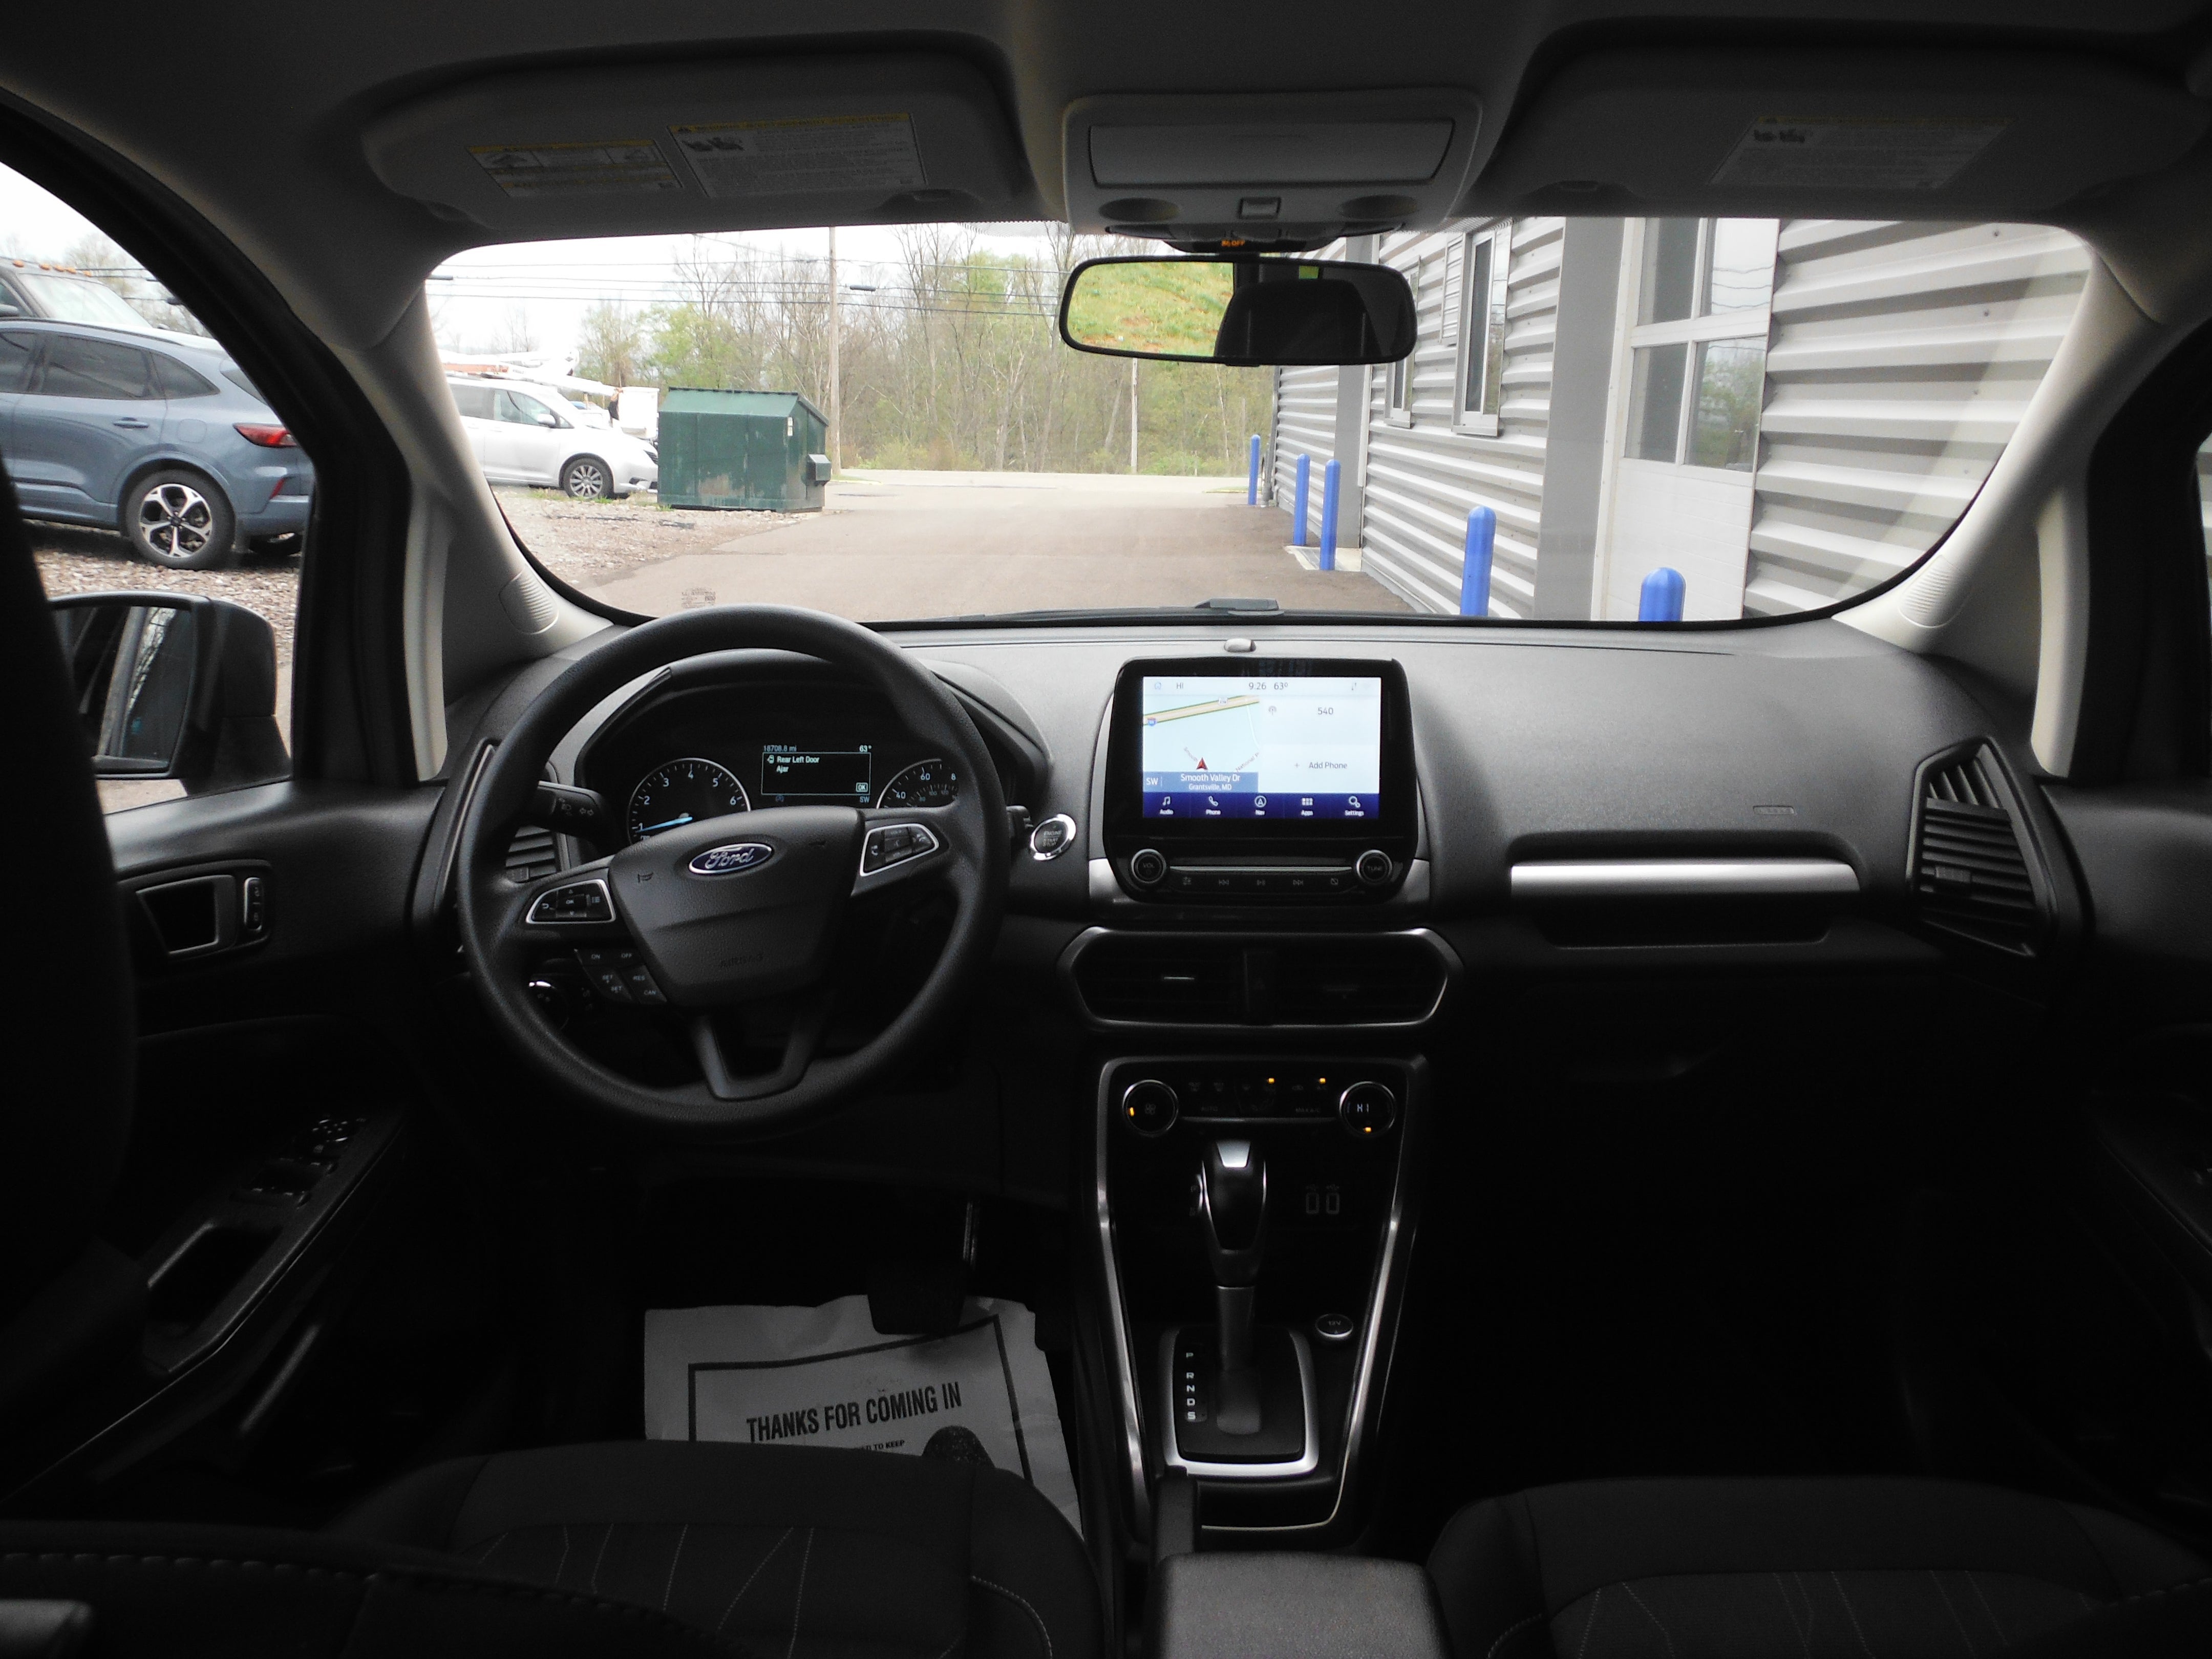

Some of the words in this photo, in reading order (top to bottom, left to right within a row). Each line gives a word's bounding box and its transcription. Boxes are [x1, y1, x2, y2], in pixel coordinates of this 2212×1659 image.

[776, 755, 791, 763] Rear
[792, 755, 804, 763] Left
[805, 755, 820, 763] Door
[776, 765, 789, 774] Ajar
[688, 770, 694, 780] 4
[1180, 773, 1208, 782] Smooth
[1209, 773, 1231, 782] Valley
[1232, 773, 1240, 781] Dr
[663, 778, 670, 787] 3
[712, 777, 719, 787] 5
[895, 791, 906, 799] 40
[644, 795, 650, 805] 2
[729, 795, 736, 806] 6
[639, 822, 644, 831] 1
[705, 846, 755, 869] Ford
[1186, 1397, 1196, 1406] D
[746, 1408, 819, 1442] THANKS
[824, 1401, 861, 1431] FOR
[866, 1386, 939, 1423] COMING
[942, 1381, 962, 1409] IN
[1187, 1411, 1196, 1420] S
[873, 1443, 884, 1451] TO
[885, 1439, 905, 1449] KEEP
